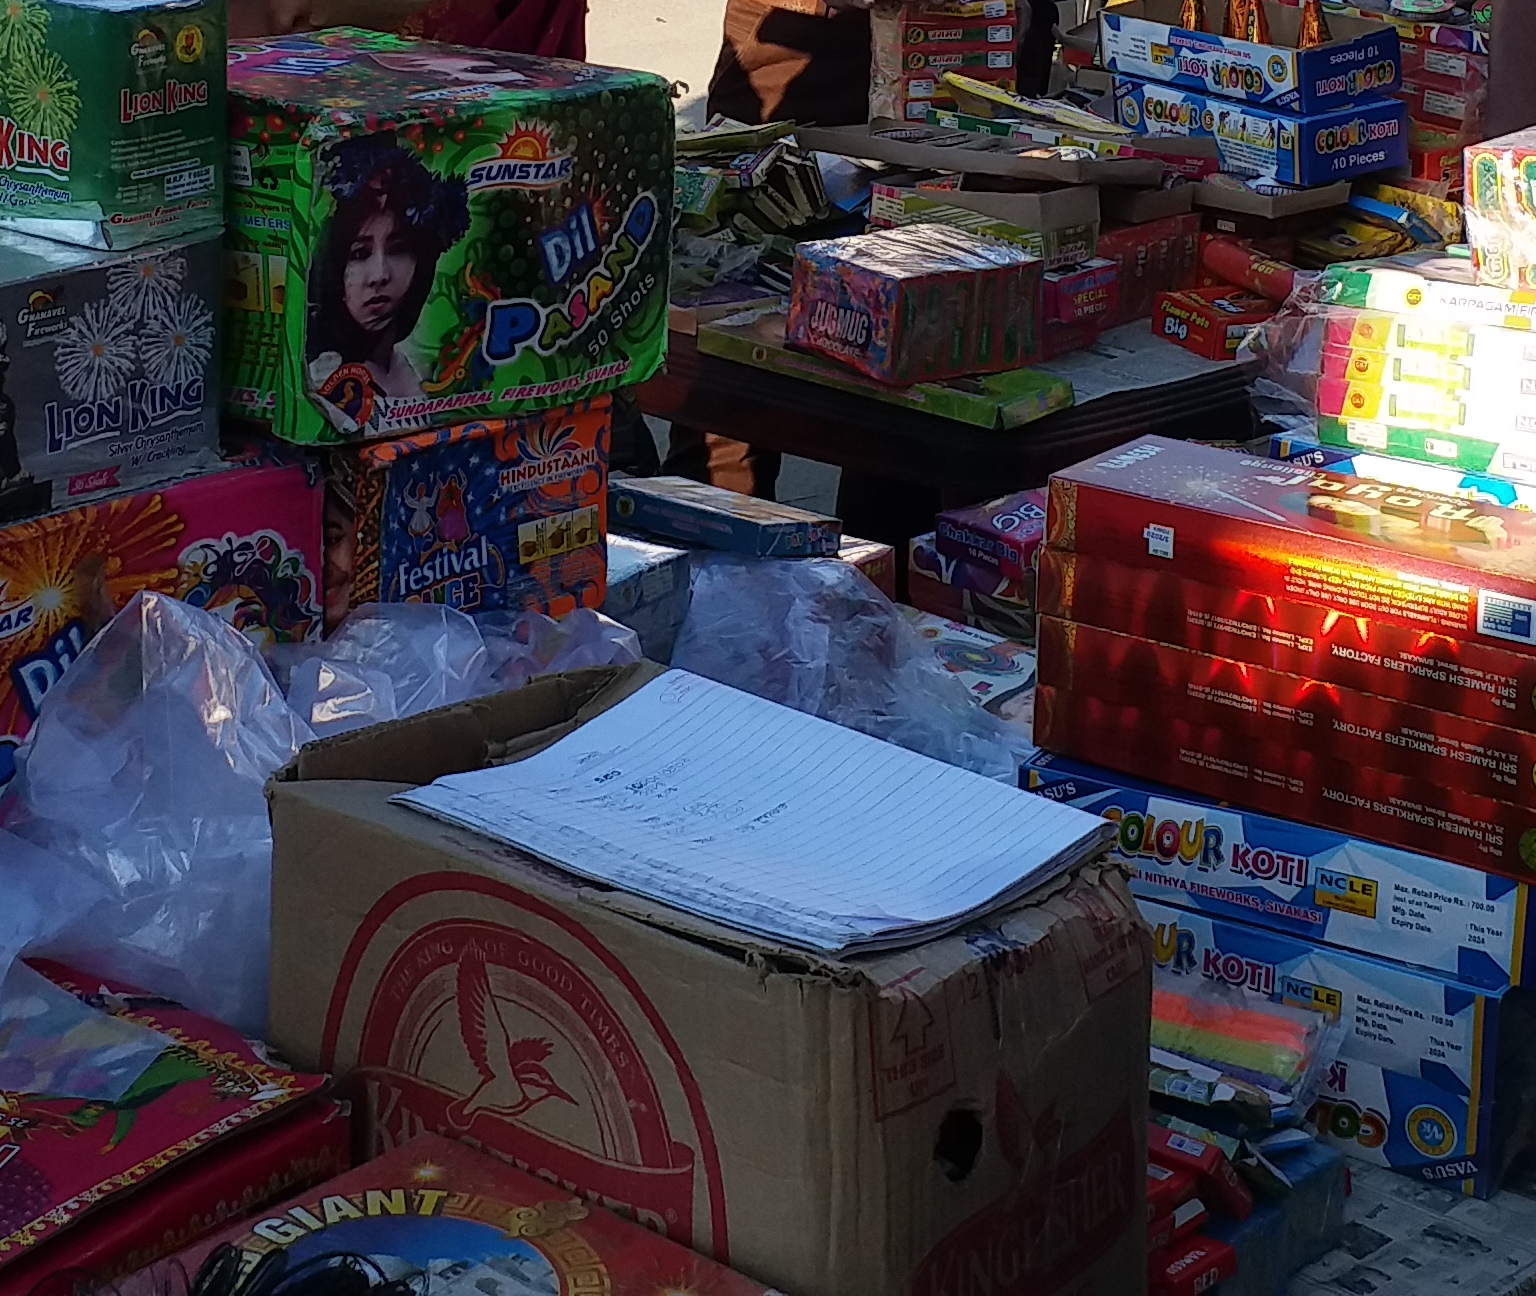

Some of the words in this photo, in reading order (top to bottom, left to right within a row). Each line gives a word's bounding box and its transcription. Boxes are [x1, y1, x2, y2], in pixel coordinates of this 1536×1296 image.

[1330, 48, 1365, 64] Pieces
[1367, 45, 1380, 58] 10
[1176, 56, 1209, 78] KOTI
[1210, 62, 1264, 94] COLOUR
[1346, 60, 1395, 97] COLOUR
[1315, 74, 1346, 97] KOTI
[120, 88, 164, 123] LION
[165, 78, 208, 115] KING
[1144, 95, 1200, 129] COLOUR
[1315, 119, 1369, 154] COLOUR
[1369, 118, 1399, 140] KOTI
[469, 157, 572, 186] SUNSTAR
[1332, 156, 1347, 171] 10
[1349, 150, 1385, 168] Pieces
[540, 204, 599, 284] Dil
[485, 192, 660, 364] PASAND
[587, 330, 610, 356] 50
[610, 272, 656, 329] Shots
[810, 299, 870, 346] JUGMUG
[1163, 316, 1188, 341] Big
[45, 395, 123, 456] LION
[127, 376, 205, 433] KING
[500, 449, 596, 486] HINDUSTAANI
[398, 534, 490, 597] Festival
[1329, 644, 1383, 668] FACTORY,
[1383, 656, 1448, 685] SPARKLERS
[1448, 674, 1497, 695] RAMESH
[1496, 684, 1518, 699] SRI
[1331, 718, 1383, 743] FACTORY,
[1384, 732, 1448, 759] SPARKLERS
[1449, 750, 1497, 771] RAMESH
[1497, 761, 1518, 775] SRI
[1320, 785, 1372, 812] FACTORY,
[1372, 800, 1435, 830] SPARKLERS
[1436, 820, 1485, 842] RAMESH
[1484, 831, 1504, 847] SRI
[1230, 842, 1309, 888] KOTI
[1319, 871, 1375, 898] NCLE
[1145, 871, 1187, 892] NITHYA
[1265, 900, 1323, 925] SIVAKASI
[517, 949, 574, 993] GOOD
[1202, 948, 1275, 994] KOTI
[1286, 980, 1337, 1007] NCLE
[7, 1116, 30, 1128] 25
[1305, 1101, 1388, 1149] COL
[1421, 1159, 1479, 1180] VASU'S
[252, 1188, 449, 1245] GIANT
